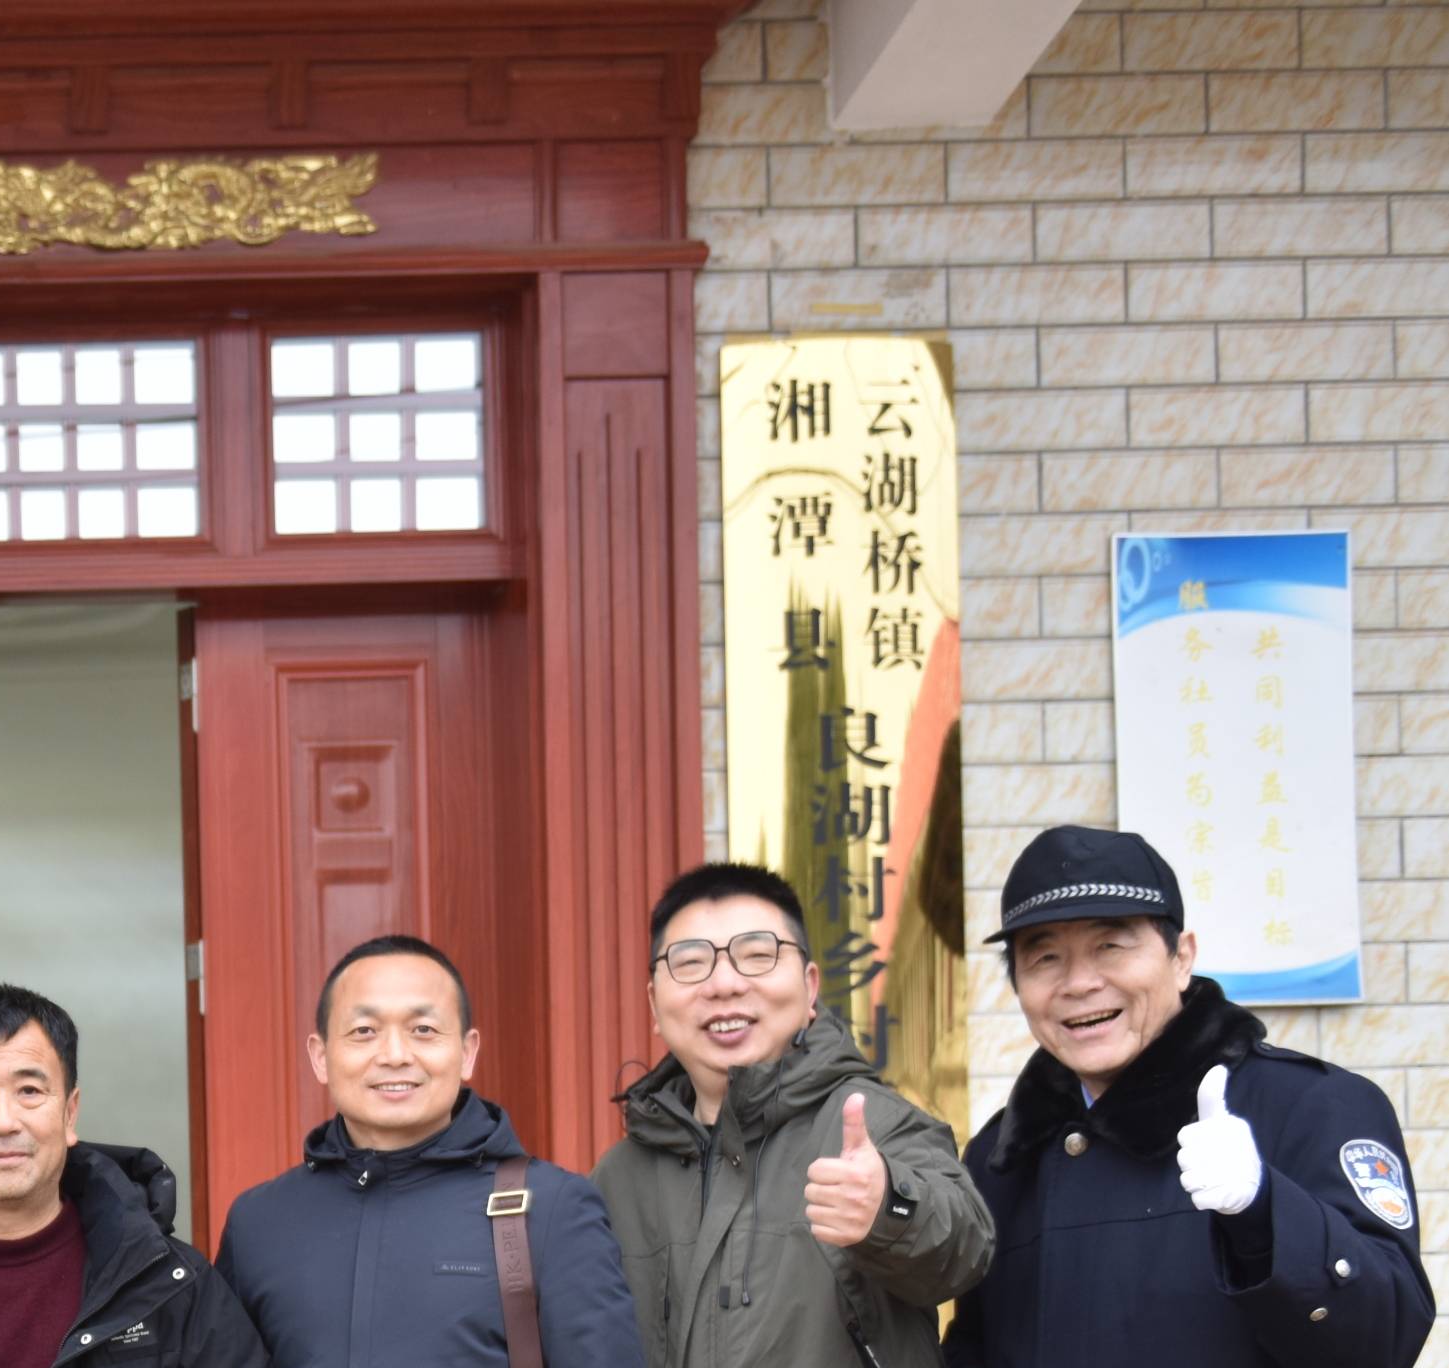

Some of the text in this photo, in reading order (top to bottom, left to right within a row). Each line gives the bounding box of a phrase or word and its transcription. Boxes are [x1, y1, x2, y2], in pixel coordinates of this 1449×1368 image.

[767, 378, 835, 672] 湘潭县
[859, 378, 925, 672] 云湖桥镇
